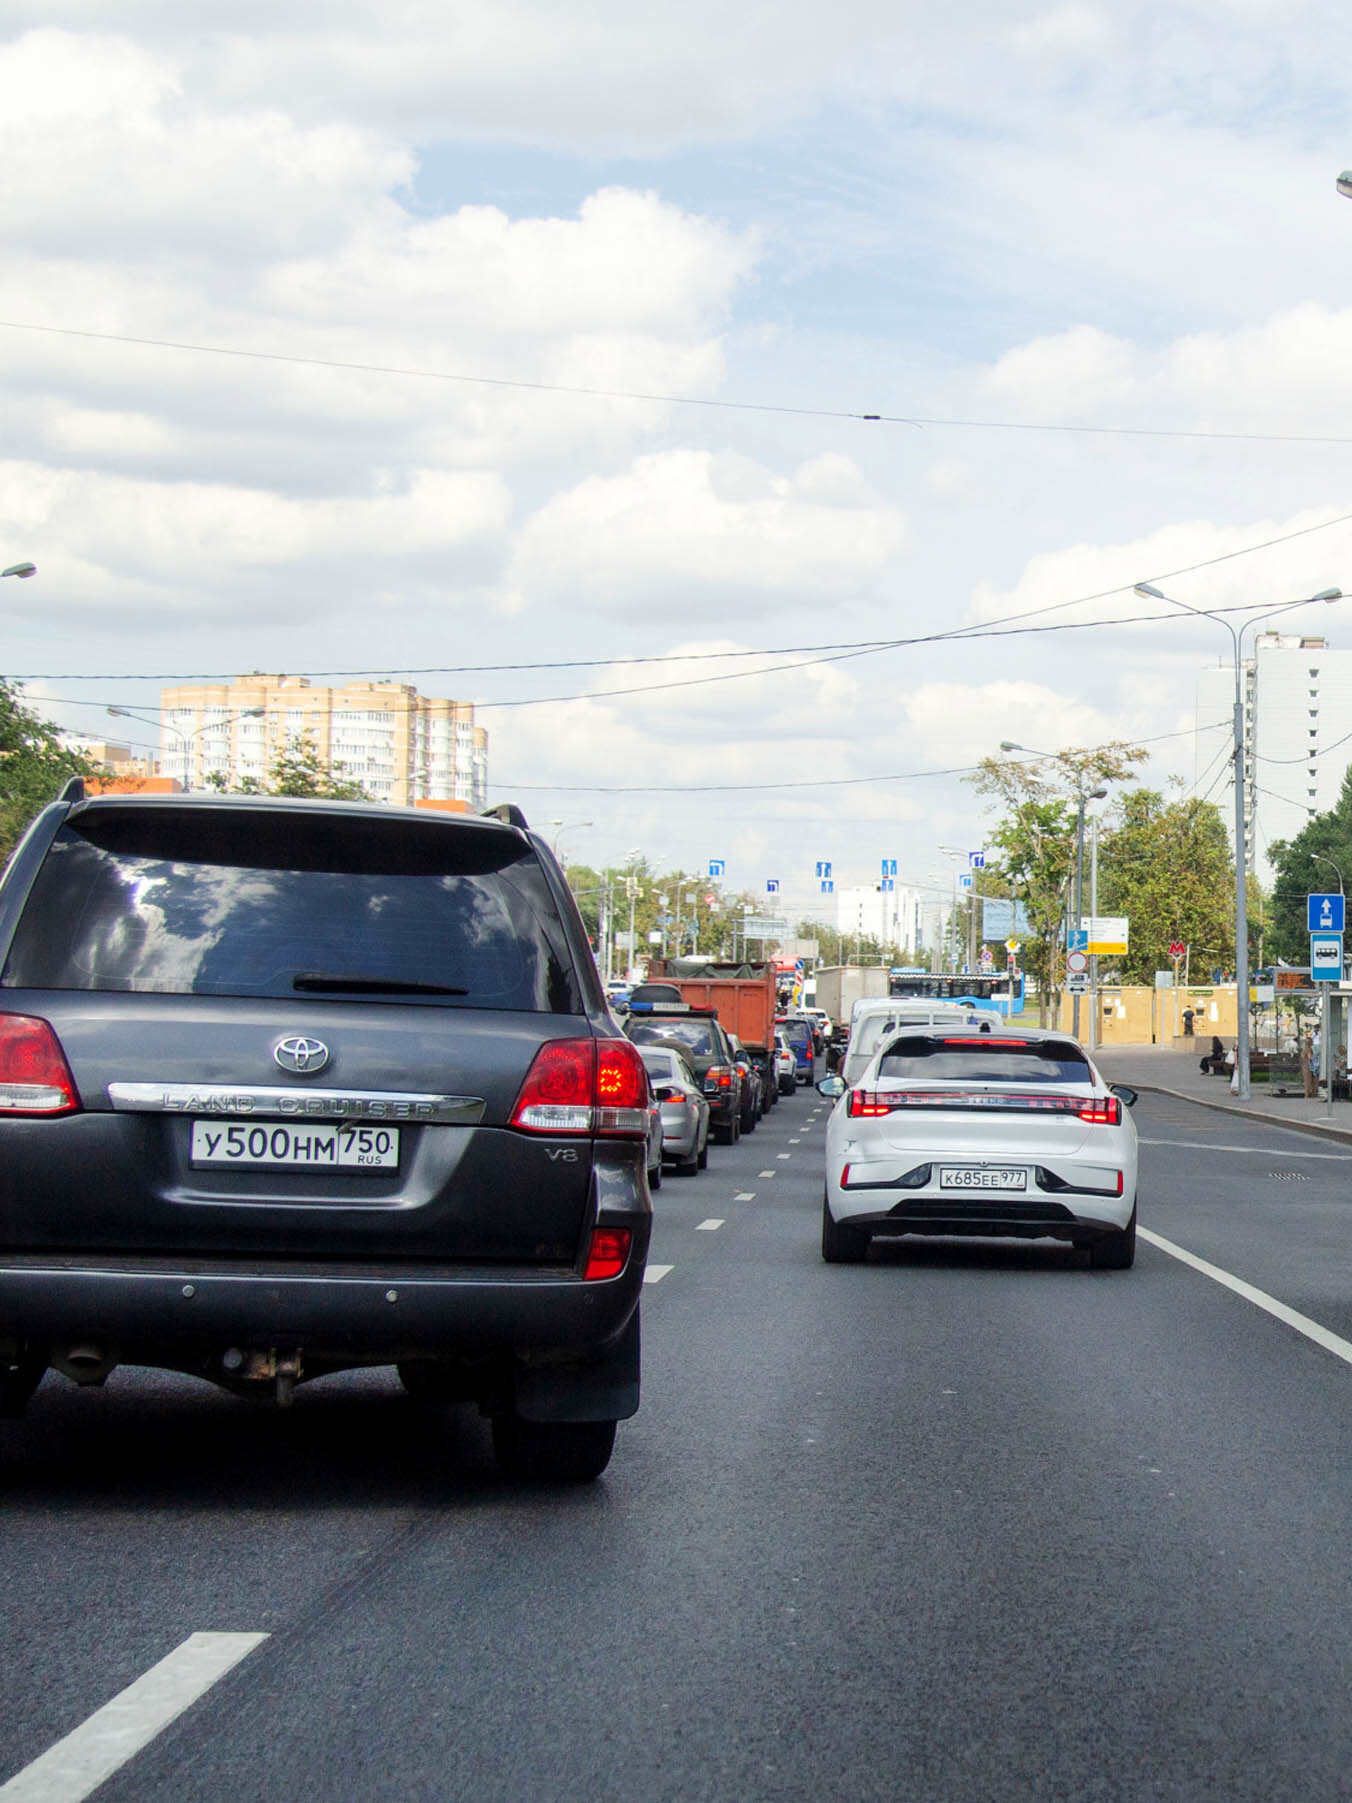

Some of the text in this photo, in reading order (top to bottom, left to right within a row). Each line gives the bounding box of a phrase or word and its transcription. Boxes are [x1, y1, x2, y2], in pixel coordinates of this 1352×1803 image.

[162, 1093, 438, 1121] LAND CRUISER
[340, 1129, 391, 1156] 750
[357, 1155, 383, 1165] RUS
[544, 1147, 579, 1162] V8
[1001, 1172, 1022, 1184] 977
